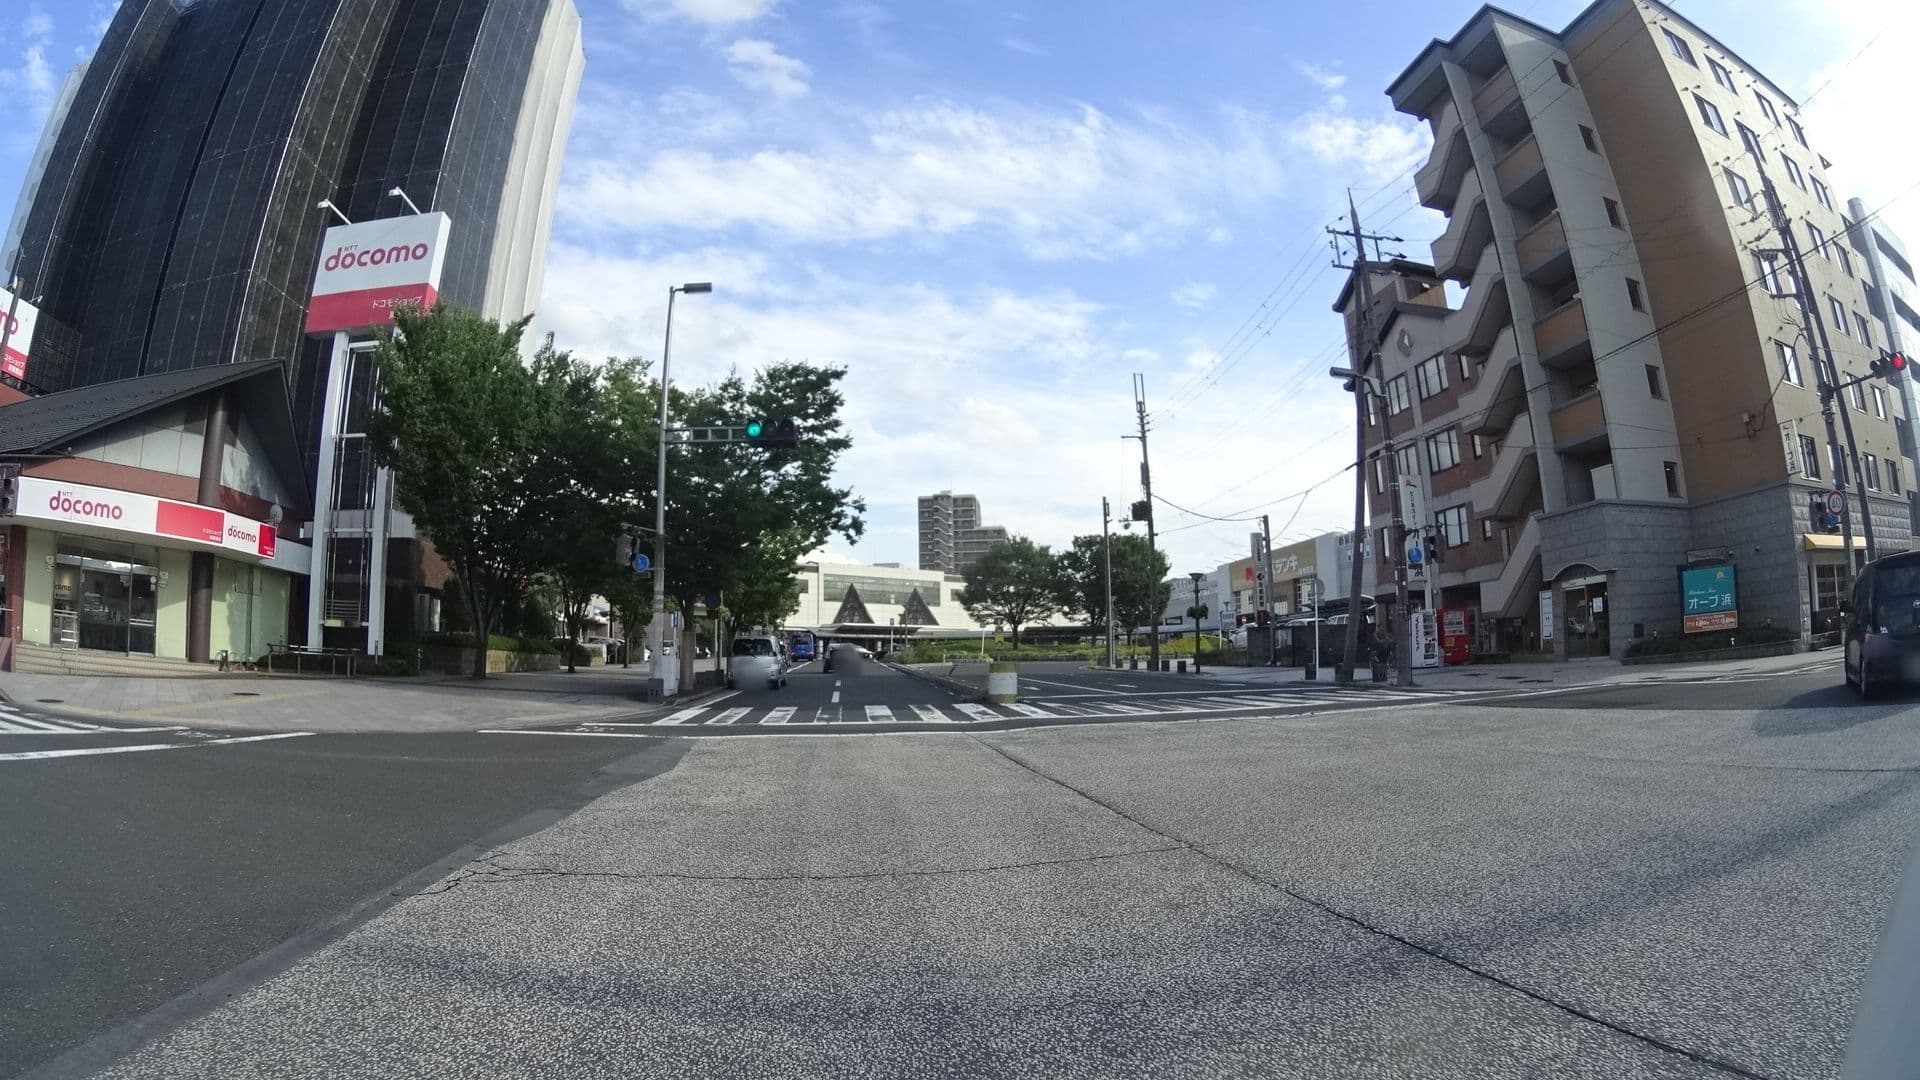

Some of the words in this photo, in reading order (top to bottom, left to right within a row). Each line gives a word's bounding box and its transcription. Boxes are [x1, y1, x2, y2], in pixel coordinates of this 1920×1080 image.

[343, 244, 358, 252] NTT
[324, 243, 428, 272] docomo
[372, 296, 422, 309] ドコモショップ
[49, 490, 122, 520] docomo
[227, 527, 257, 543] docomo
